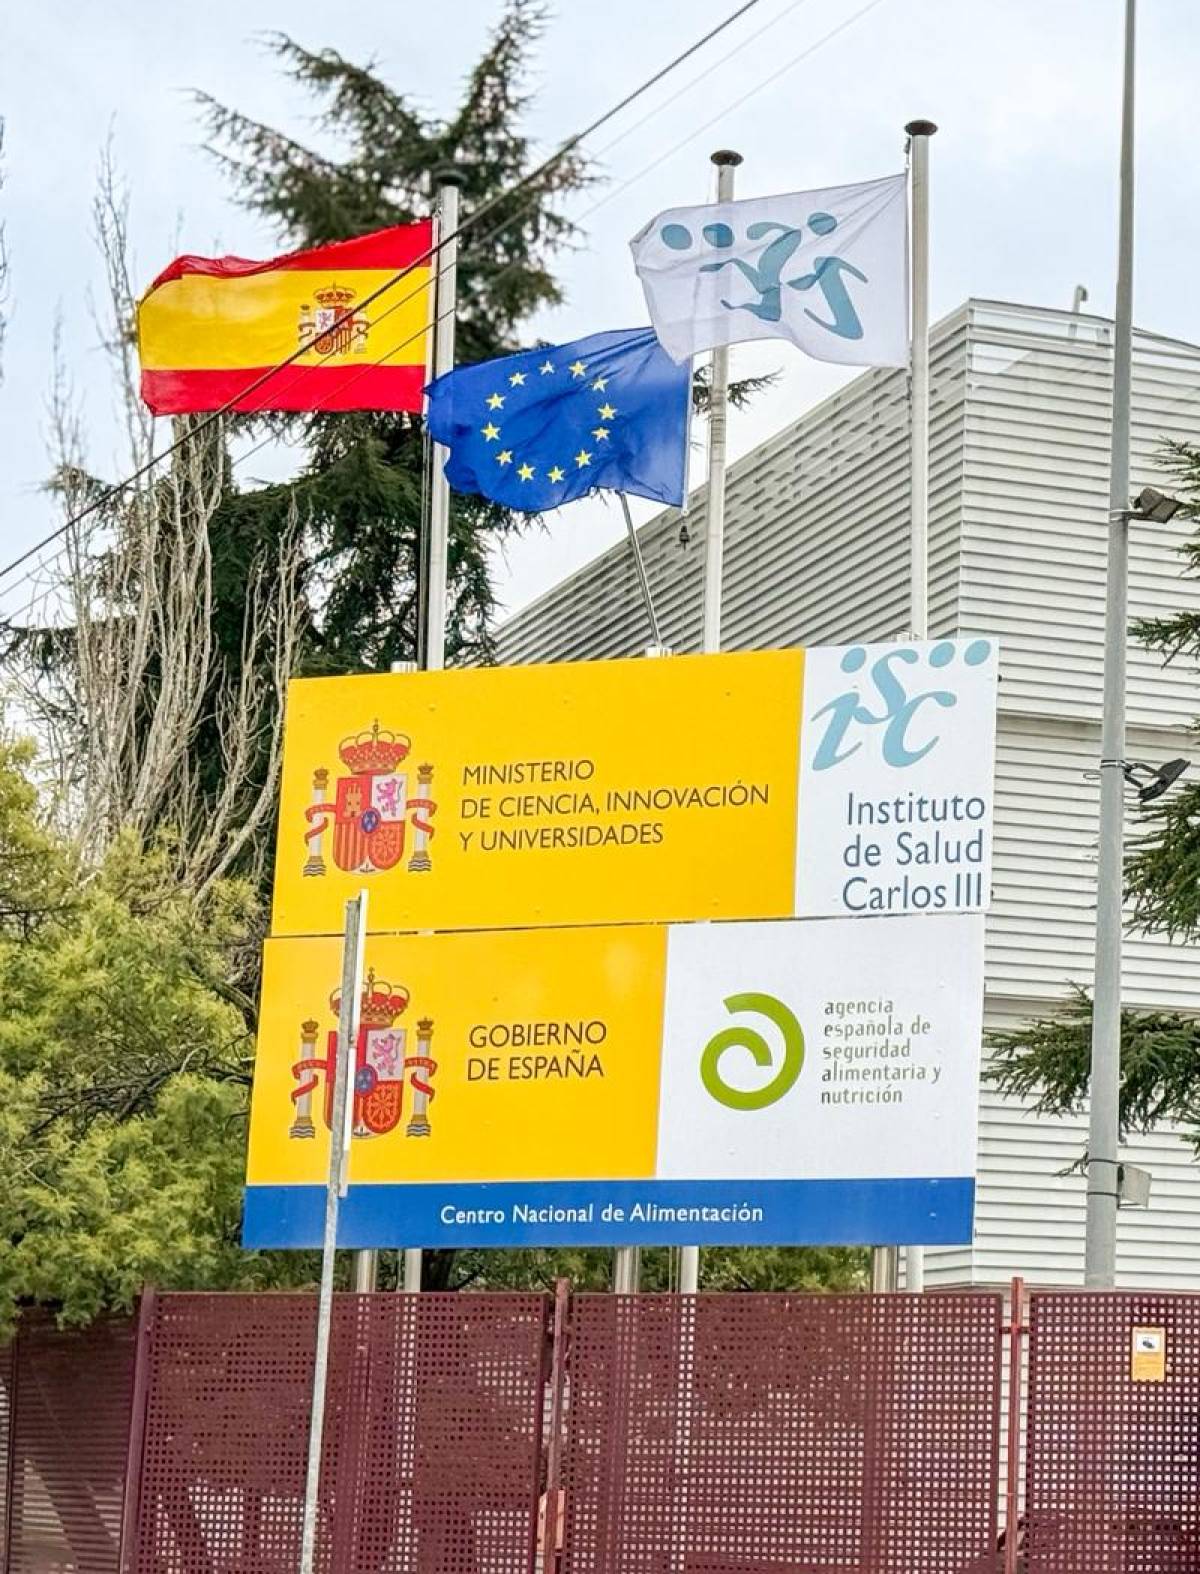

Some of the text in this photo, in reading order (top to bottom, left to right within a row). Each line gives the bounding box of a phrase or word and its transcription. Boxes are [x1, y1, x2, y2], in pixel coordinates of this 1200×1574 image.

[462, 759, 595, 786] MINISTERIO
[460, 780, 770, 820] DE CIENCIA, INNOVACIÓN
[847, 792, 986, 826] Instituto
[459, 823, 664, 852] Y UNIVERSIDADES
[843, 828, 984, 867] de Salud
[842, 873, 983, 911] Carlos III
[824, 997, 894, 1019] agencia
[469, 1020, 608, 1049] GOBIERNO
[823, 1015, 931, 1041] española de
[467, 1048, 605, 1081] DE ESPAÑA
[822, 1038, 911, 1063] seguridad
[821, 1061, 942, 1084] alimentaria y
[820, 1084, 904, 1104] nutrición
[440, 1201, 764, 1224] Centro Nacional de Alimentación
